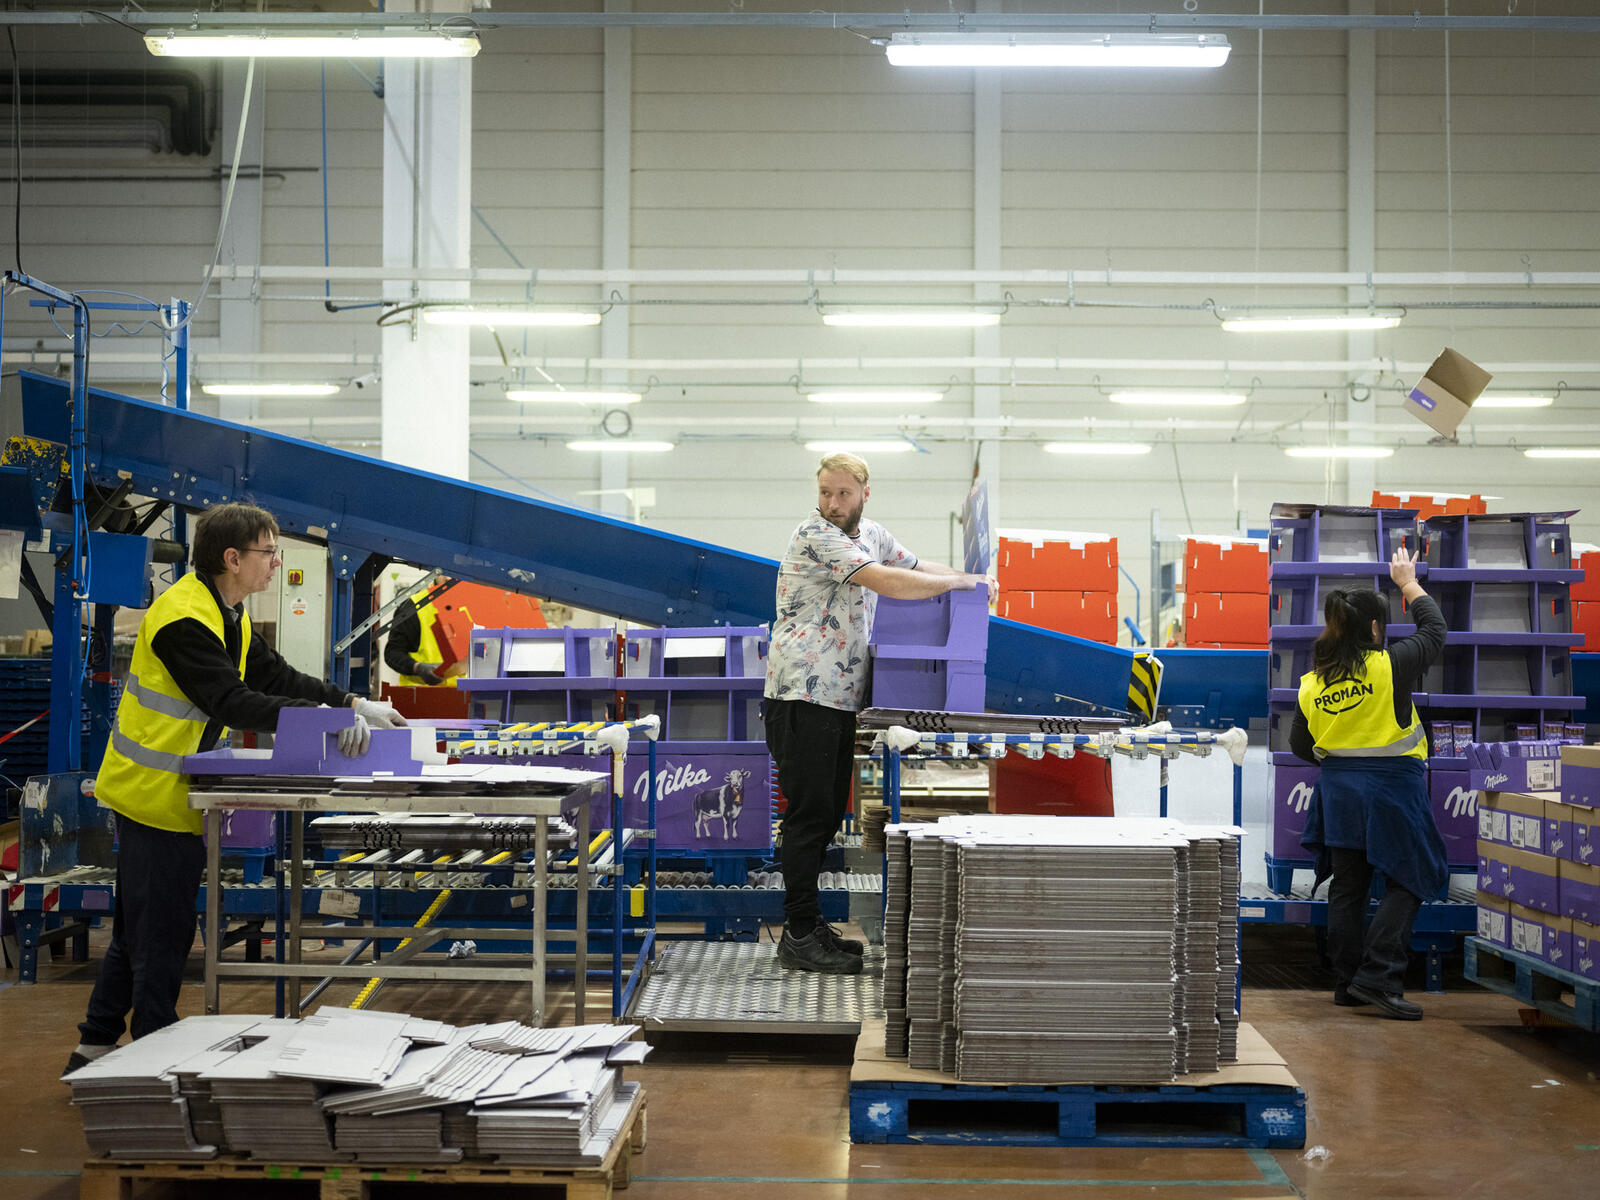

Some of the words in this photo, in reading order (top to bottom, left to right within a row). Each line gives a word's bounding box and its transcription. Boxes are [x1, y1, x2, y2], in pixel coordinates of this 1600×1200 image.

[1314, 683, 1374, 710] PROMAN
[633, 763, 711, 802] Milka
[1484, 772, 1508, 789] Milka
